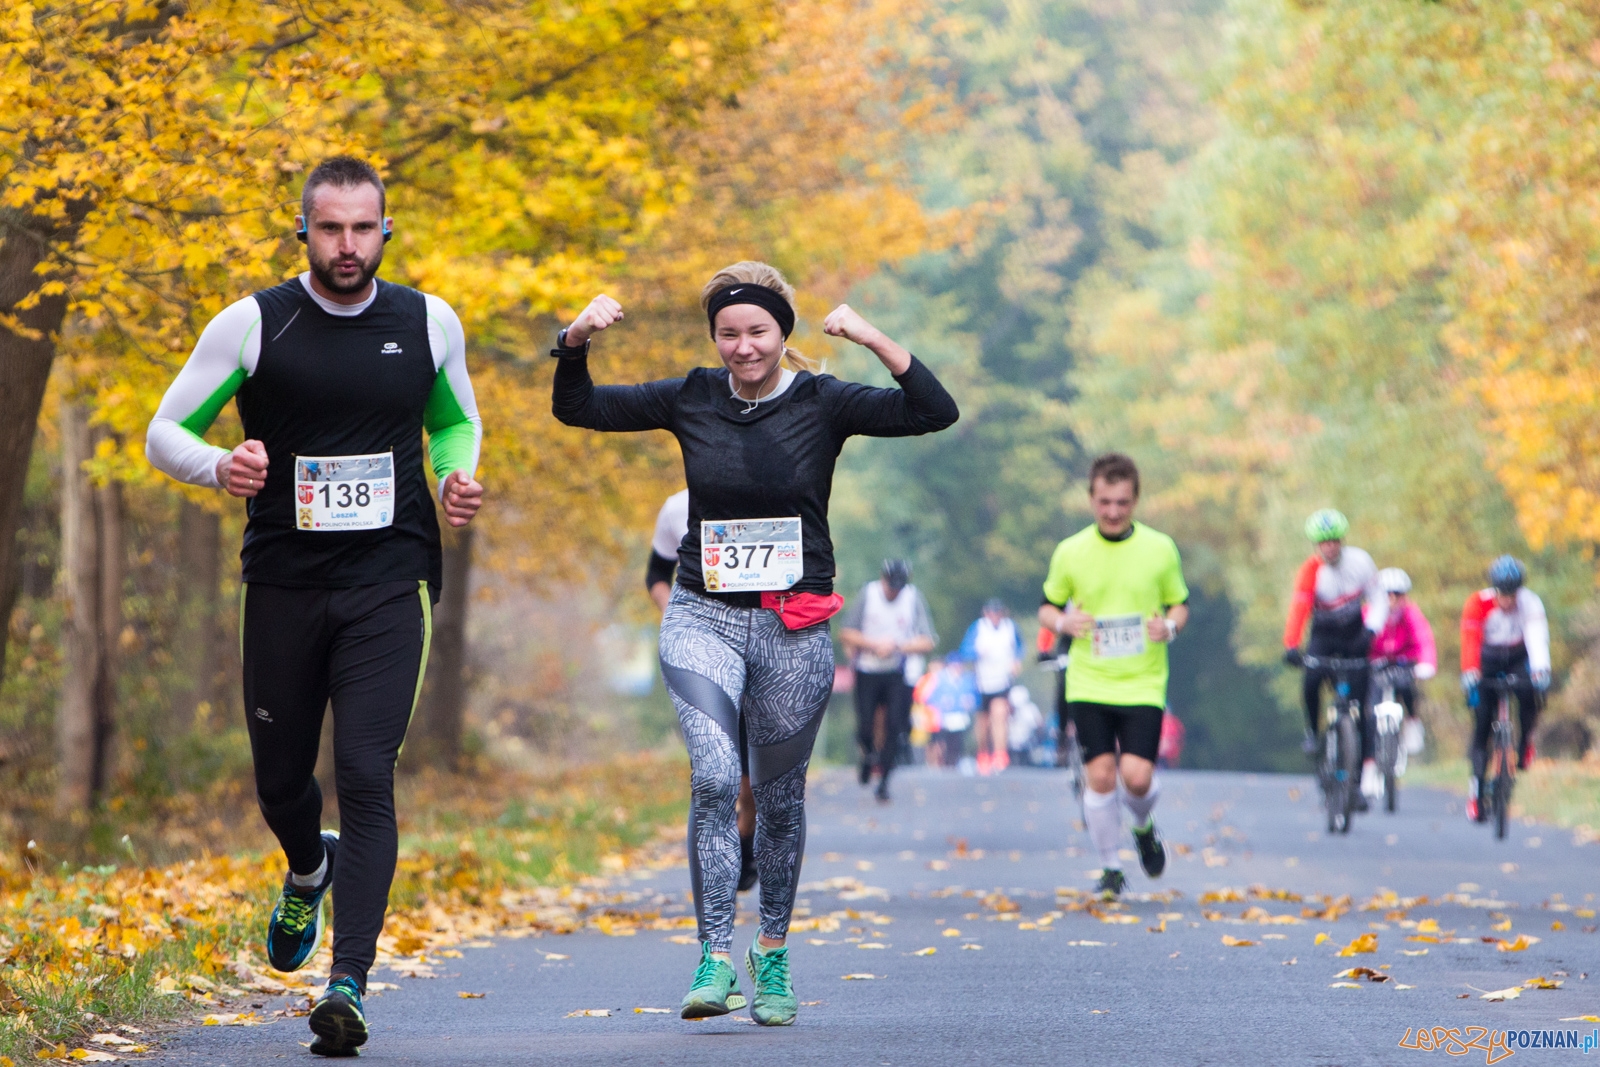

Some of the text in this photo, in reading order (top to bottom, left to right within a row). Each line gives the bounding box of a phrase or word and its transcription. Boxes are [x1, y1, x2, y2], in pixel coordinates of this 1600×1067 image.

[318, 482, 371, 508] 138
[331, 511, 359, 519] Leszek
[724, 544, 775, 569] 377
[739, 572, 761, 580] Agata
